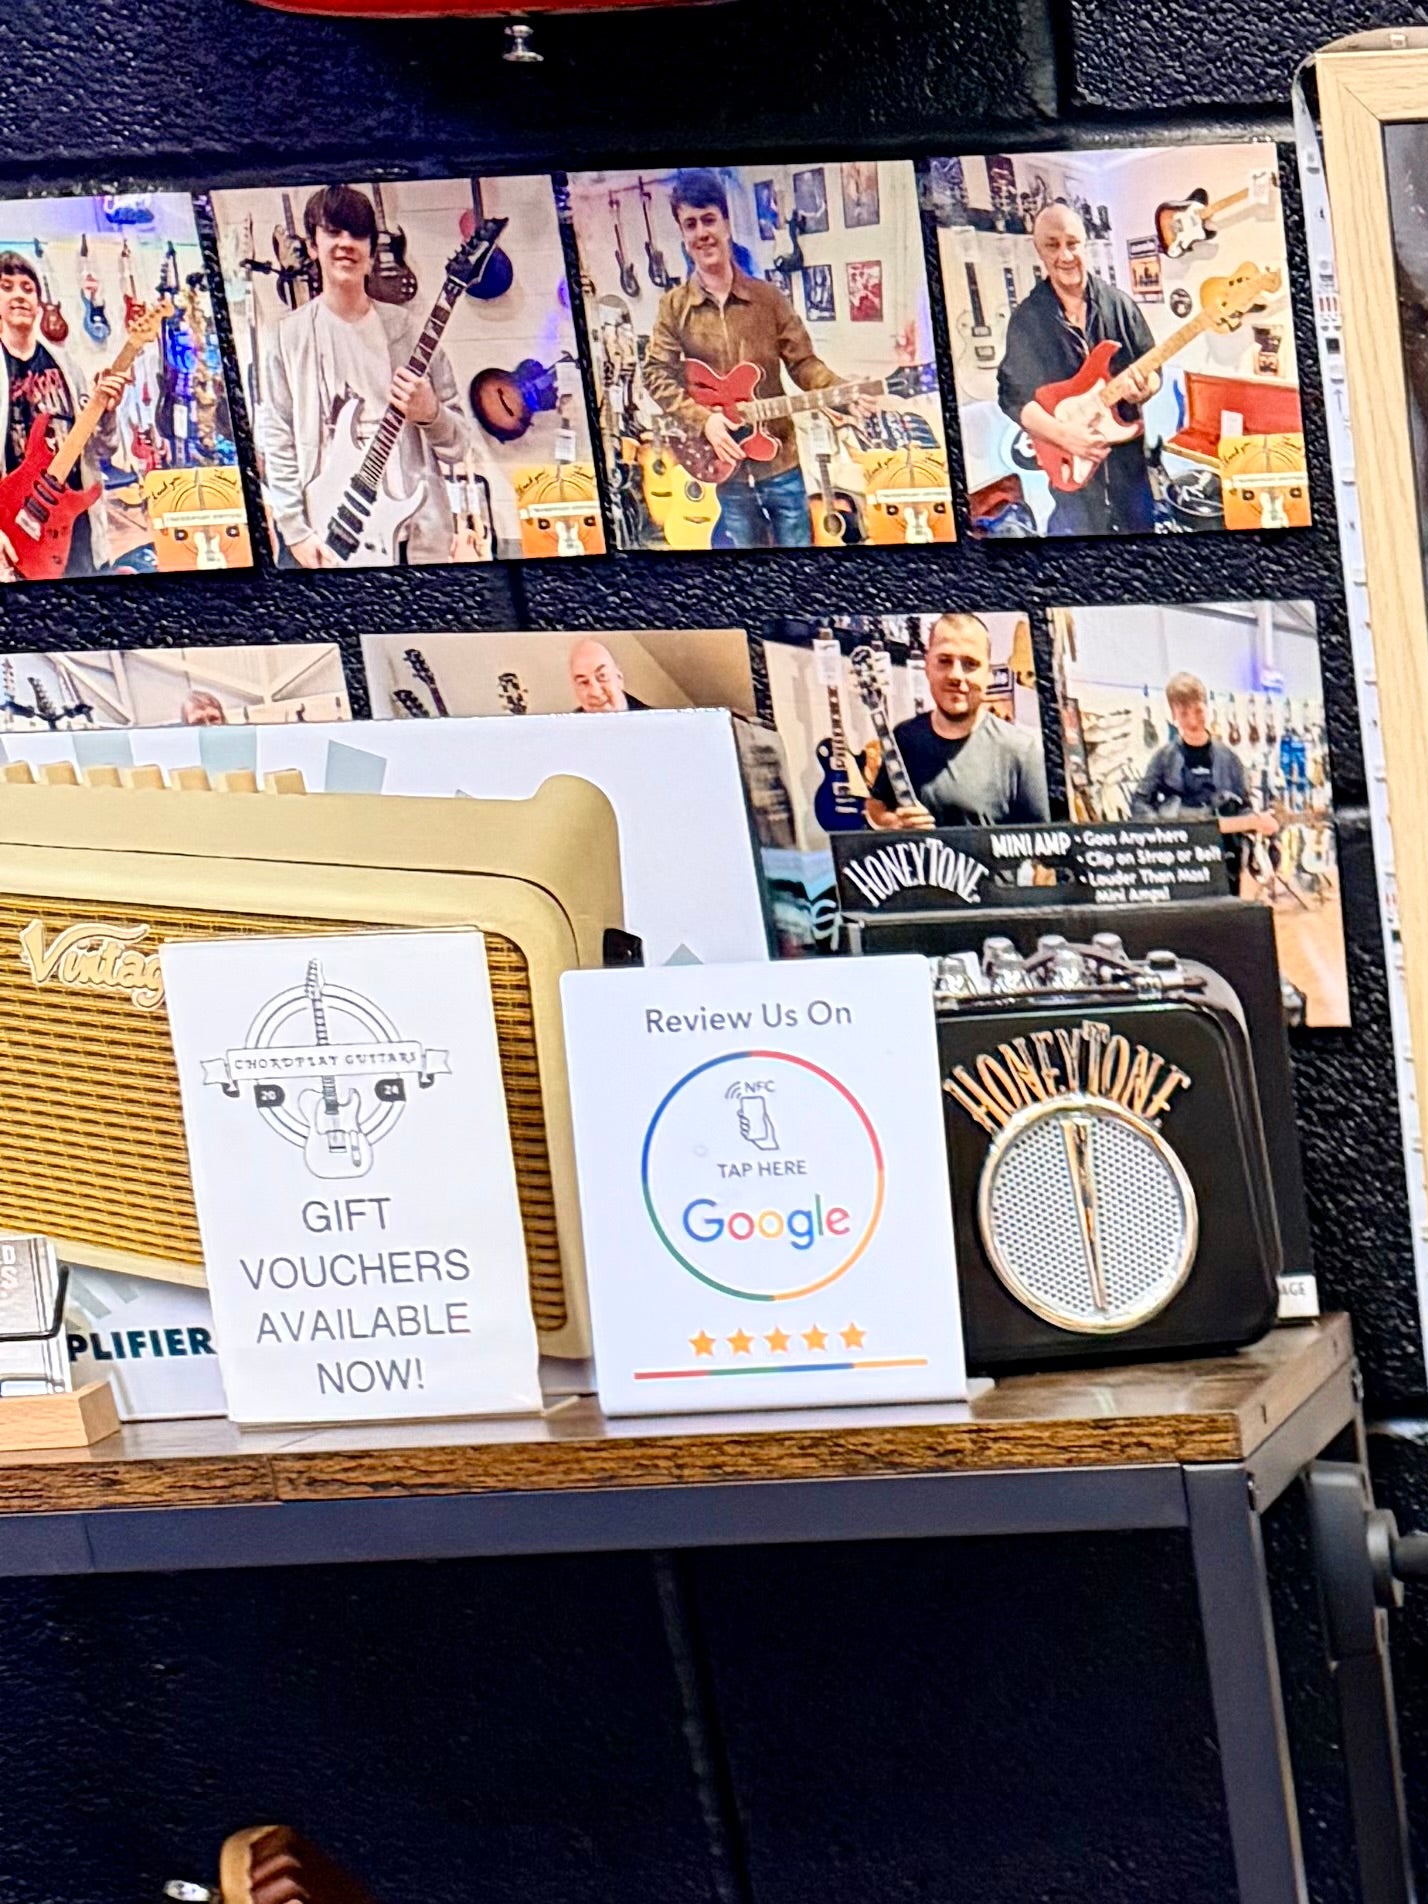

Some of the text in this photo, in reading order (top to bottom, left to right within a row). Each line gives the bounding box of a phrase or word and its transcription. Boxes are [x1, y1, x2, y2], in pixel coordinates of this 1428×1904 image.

[991, 831, 1072, 858] MINI AMP
[842, 836, 990, 909] HONEYTONE
[19, 917, 166, 1012] Vintag
[645, 999, 853, 1034] Review Us On
[233, 1051, 418, 1071] CHORDPLAY GUITARS
[942, 1018, 1193, 1137] HONEYTONE
[743, 1079, 776, 1094] NFC
[716, 1159, 809, 1179] TAP HERE
[301, 1197, 392, 1233] GIFT
[682, 1192, 852, 1251] Google
[239, 1248, 471, 1291] VOUCHERS
[255, 1301, 472, 1345] AVAILABLE
[66, 1326, 218, 1363] PLIFIER
[316, 1357, 425, 1396] NOW!
